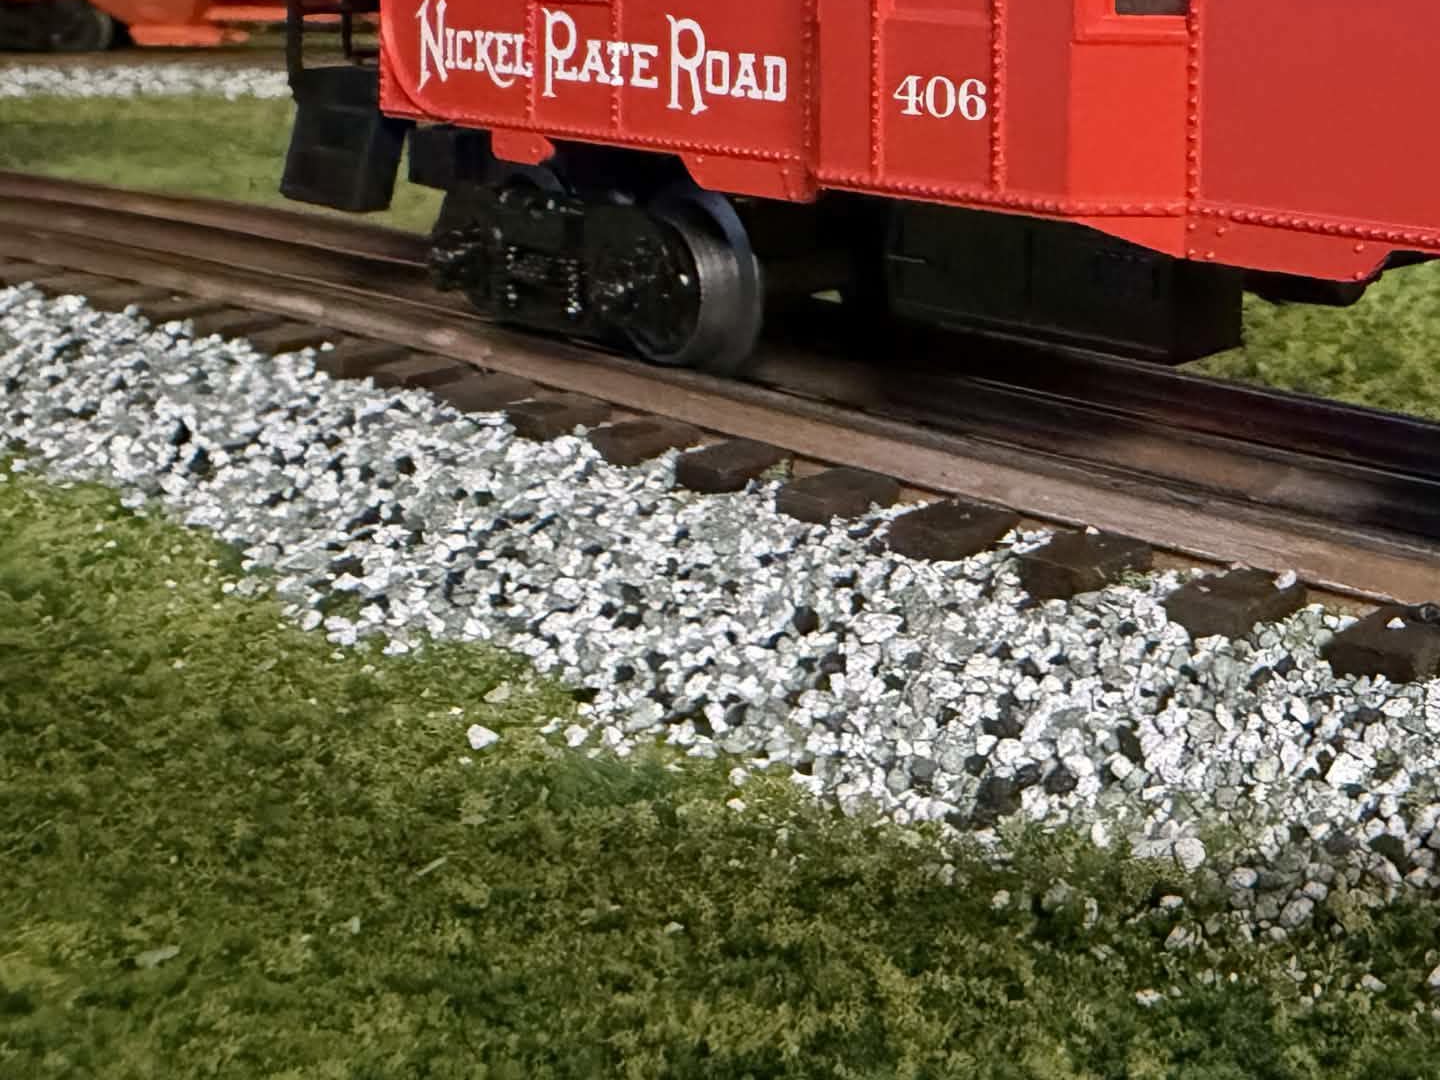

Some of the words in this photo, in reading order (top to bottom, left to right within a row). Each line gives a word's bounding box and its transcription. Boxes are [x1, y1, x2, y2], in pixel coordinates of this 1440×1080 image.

[540, 7, 659, 98] PLATE
[665, 14, 788, 115] ROAD
[892, 75, 987, 121] 406
